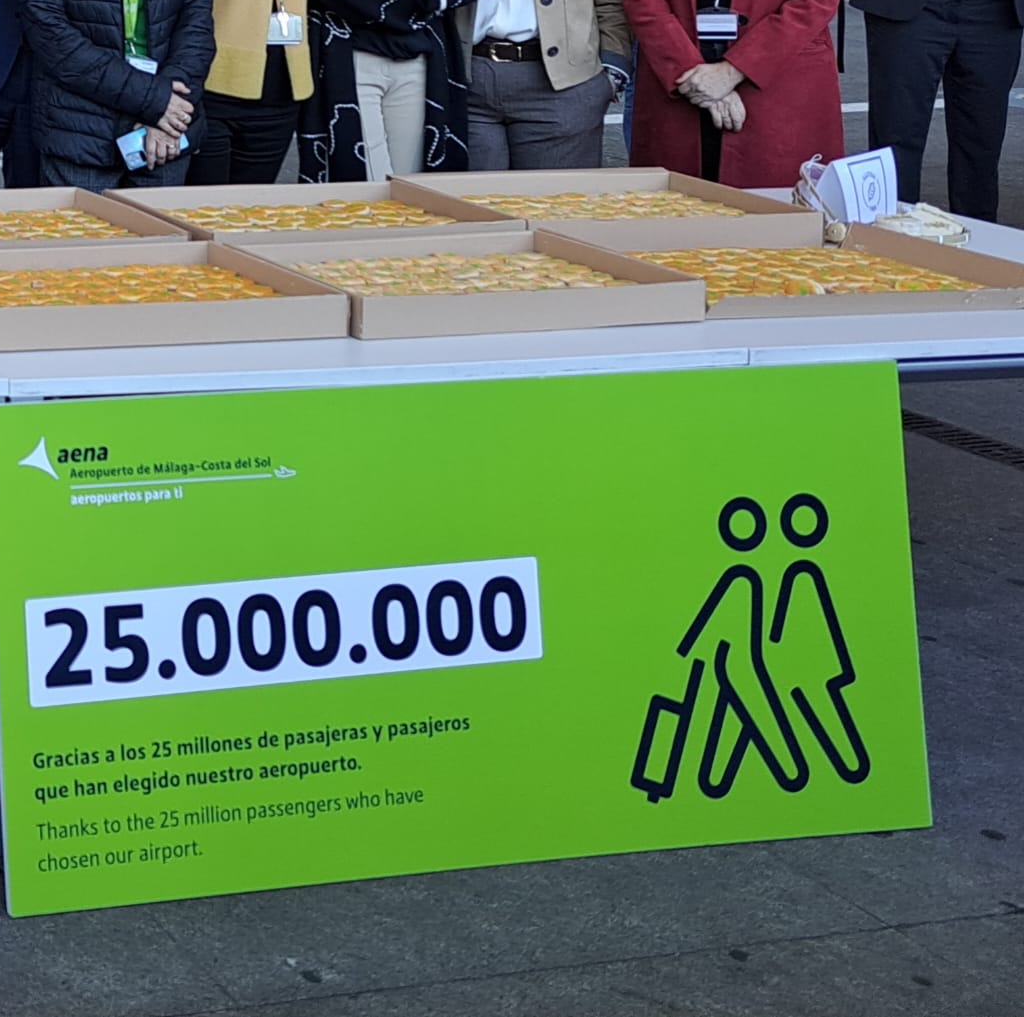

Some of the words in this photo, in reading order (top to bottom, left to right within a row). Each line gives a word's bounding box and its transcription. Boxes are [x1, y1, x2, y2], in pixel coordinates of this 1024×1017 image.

[57, 445, 109, 464] aena
[69, 464, 133, 480] Aeropuerto
[136, 463, 151, 476] de
[153, 459, 232, 476] Málaga-Costa
[234, 458, 252, 470] del
[254, 456, 272, 469] Sol
[70, 490, 143, 507] aeropuertos
[145, 489, 172, 503] para
[174, 486, 184, 499] ti
[44, 575, 527, 688] 25.000.000
[32, 748, 100, 770] Gracias
[105, 749, 116, 763] a
[120, 743, 147, 762] los
[151, 740, 173, 759] 25
[177, 734, 253, 756] millones
[257, 731, 280, 749] de
[284, 723, 369, 750] pasajeras
[372, 725, 384, 742] y
[388, 715, 471, 742] pasajeros
[34, 785, 69, 804] que
[74, 778, 108, 797] han
[113, 770, 181, 795] elegido
[185, 765, 255, 786] nuestro
[259, 754, 363, 781] aeropuerto.
[36, 819, 99, 841] Thanks
[103, 818, 122, 834] to
[126, 813, 155, 832] the
[159, 810, 180, 828] 25
[183, 804, 242, 826] million
[246, 794, 342, 824] passengers
[346, 791, 381, 811] who
[385, 787, 424, 806] have
[38, 850, 100, 873] chosen
[105, 848, 134, 865] our
[139, 840, 204, 864] airport.
